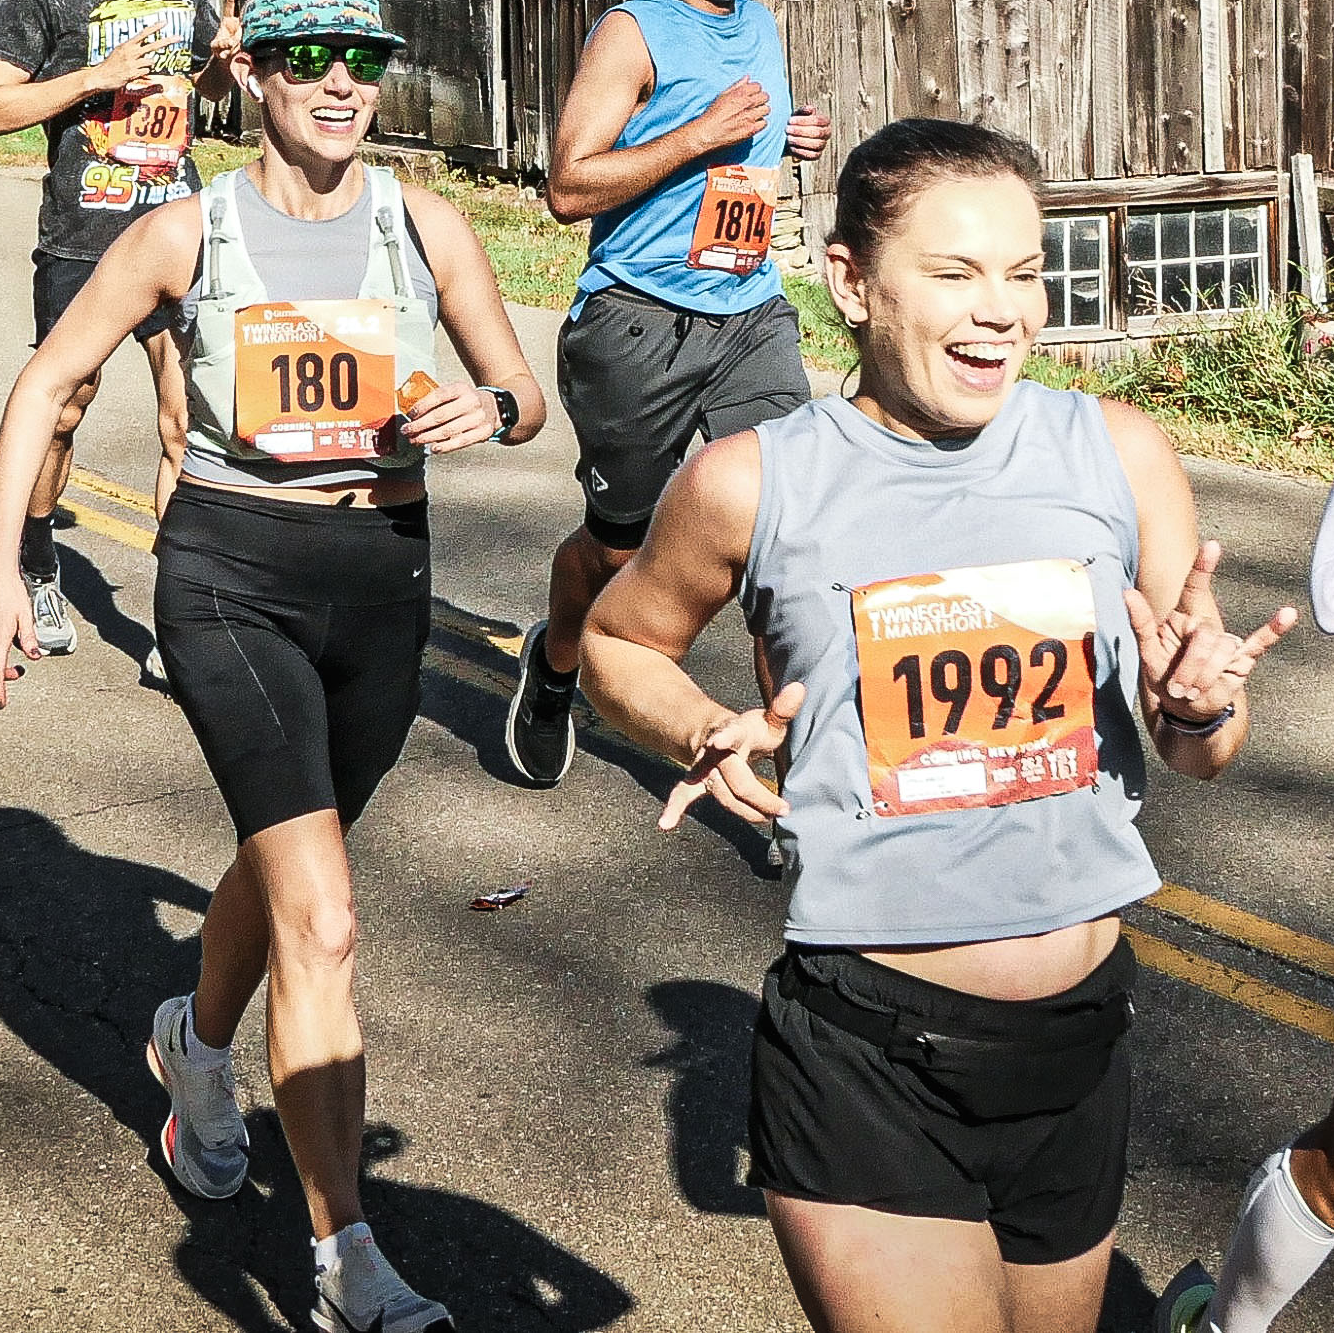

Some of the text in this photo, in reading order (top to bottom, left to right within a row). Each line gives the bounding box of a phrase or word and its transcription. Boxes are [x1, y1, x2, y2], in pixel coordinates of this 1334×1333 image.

[125, 105, 180, 138] 1387
[80, 164, 138, 210] 95
[714, 198, 766, 244] 1814
[250, 322, 318, 334] WINEGLASS
[251, 331, 317, 344] MARATHON
[271, 352, 359, 413] 180
[878, 599, 980, 625] WINEGLASS
[885, 614, 982, 640] MARATHON
[893, 638, 1068, 739] 1992
